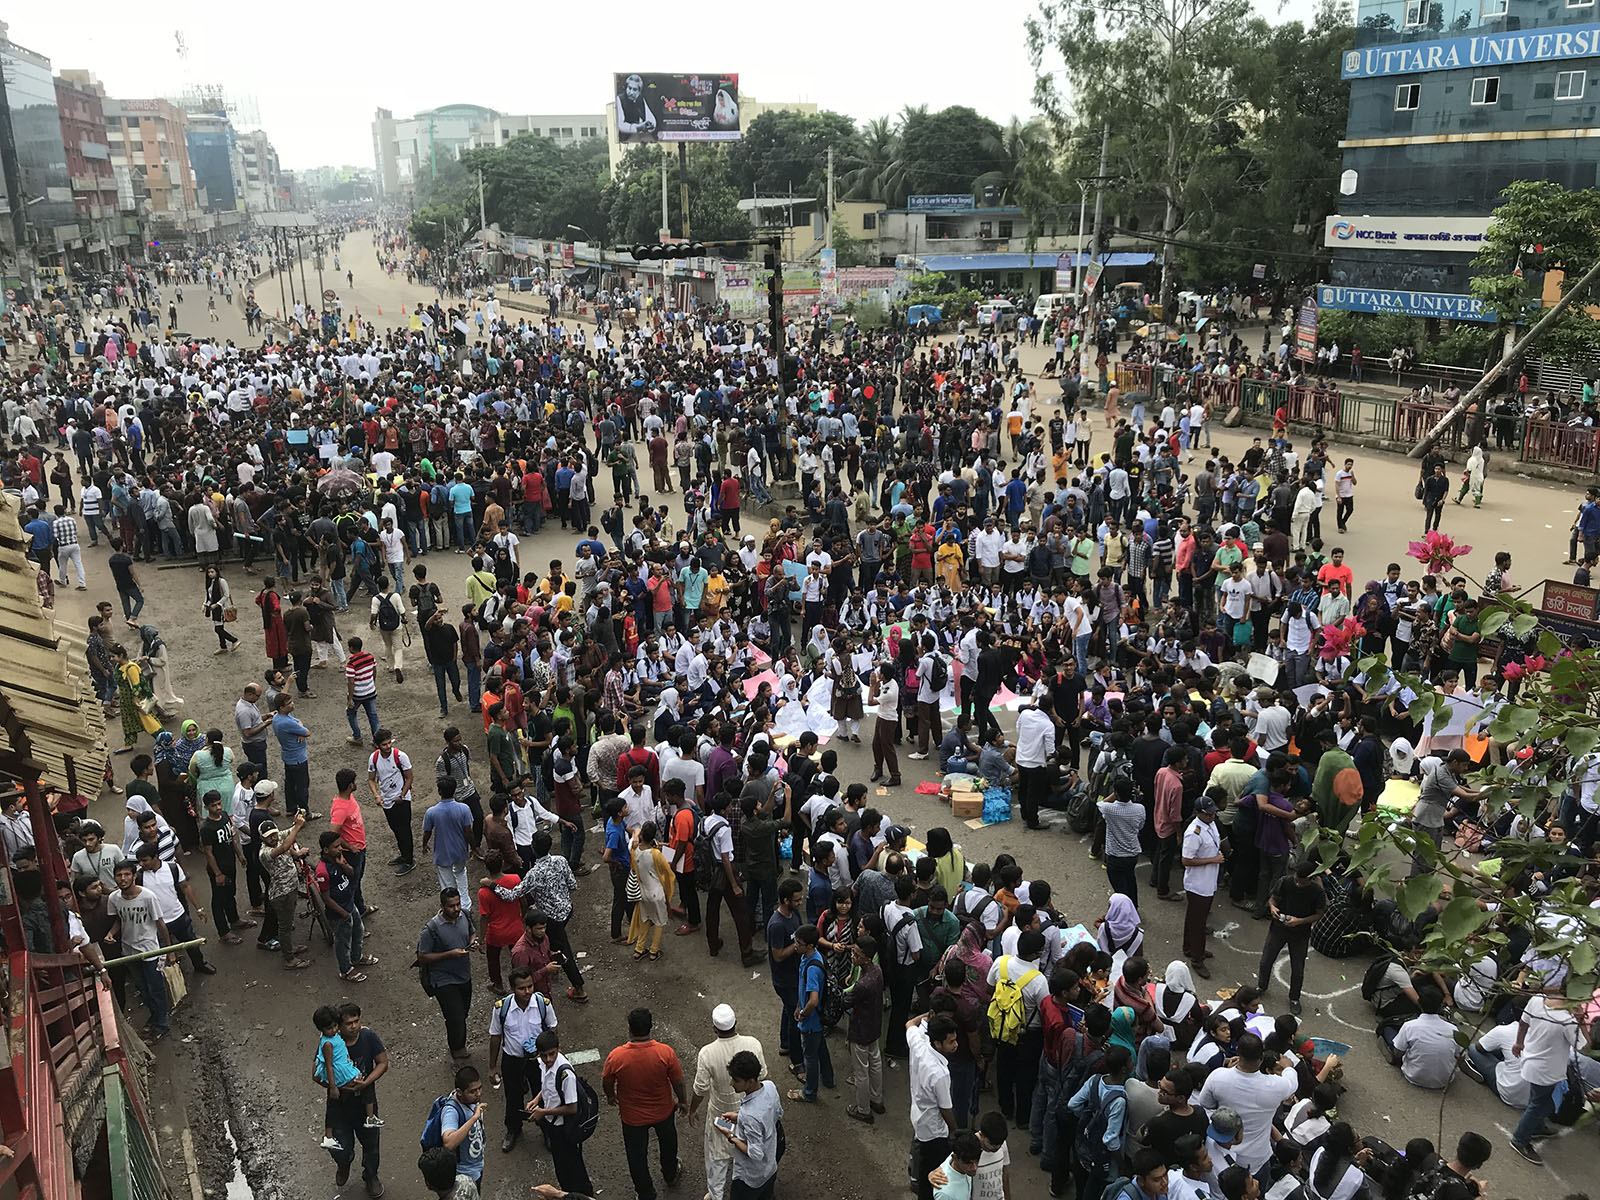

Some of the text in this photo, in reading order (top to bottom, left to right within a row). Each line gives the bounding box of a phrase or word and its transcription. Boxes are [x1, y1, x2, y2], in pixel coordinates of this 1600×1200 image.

[1365, 44, 1461, 75] UTTARA
[1356, 230, 1397, 240] NCC Bank
[1336, 288, 1484, 313] UTTARA UNIVER
[1457, 311, 1482, 320] Law
[1546, 595, 1592, 618] ভর্তি চলছে
